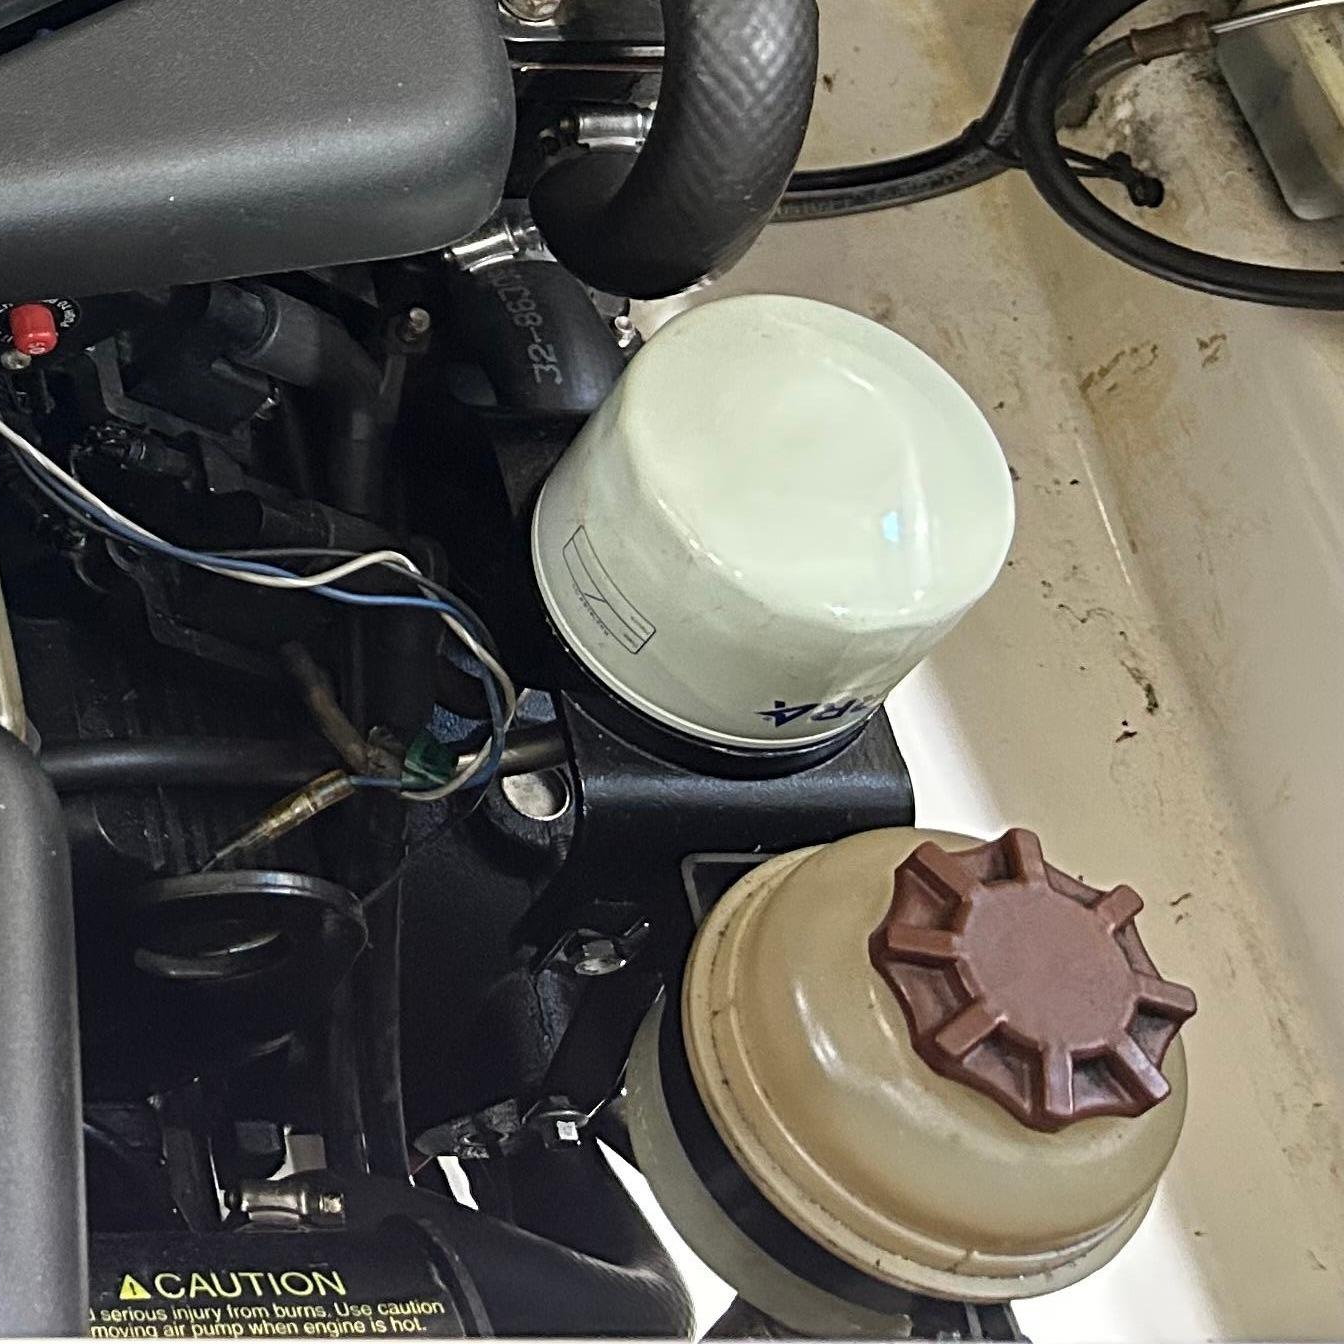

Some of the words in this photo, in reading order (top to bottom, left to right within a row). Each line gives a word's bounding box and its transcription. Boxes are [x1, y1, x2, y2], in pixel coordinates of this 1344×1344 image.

[755, 696, 874, 727] RA
[154, 1271, 346, 1300] CAUTION
[100, 1306, 168, 1322] serious
[172, 1306, 222, 1323] injury
[227, 1304, 270, 1320] from
[272, 1302, 333, 1319] burns.
[334, 1302, 373, 1317] Use
[377, 1299, 445, 1316] caution
[163, 1322, 186, 1337] air
[192, 1322, 244, 1338] pump
[248, 1319, 299, 1335] when
[303, 1318, 365, 1338] engine
[369, 1317, 387, 1334] is
[390, 1316, 427, 1333] hot.
